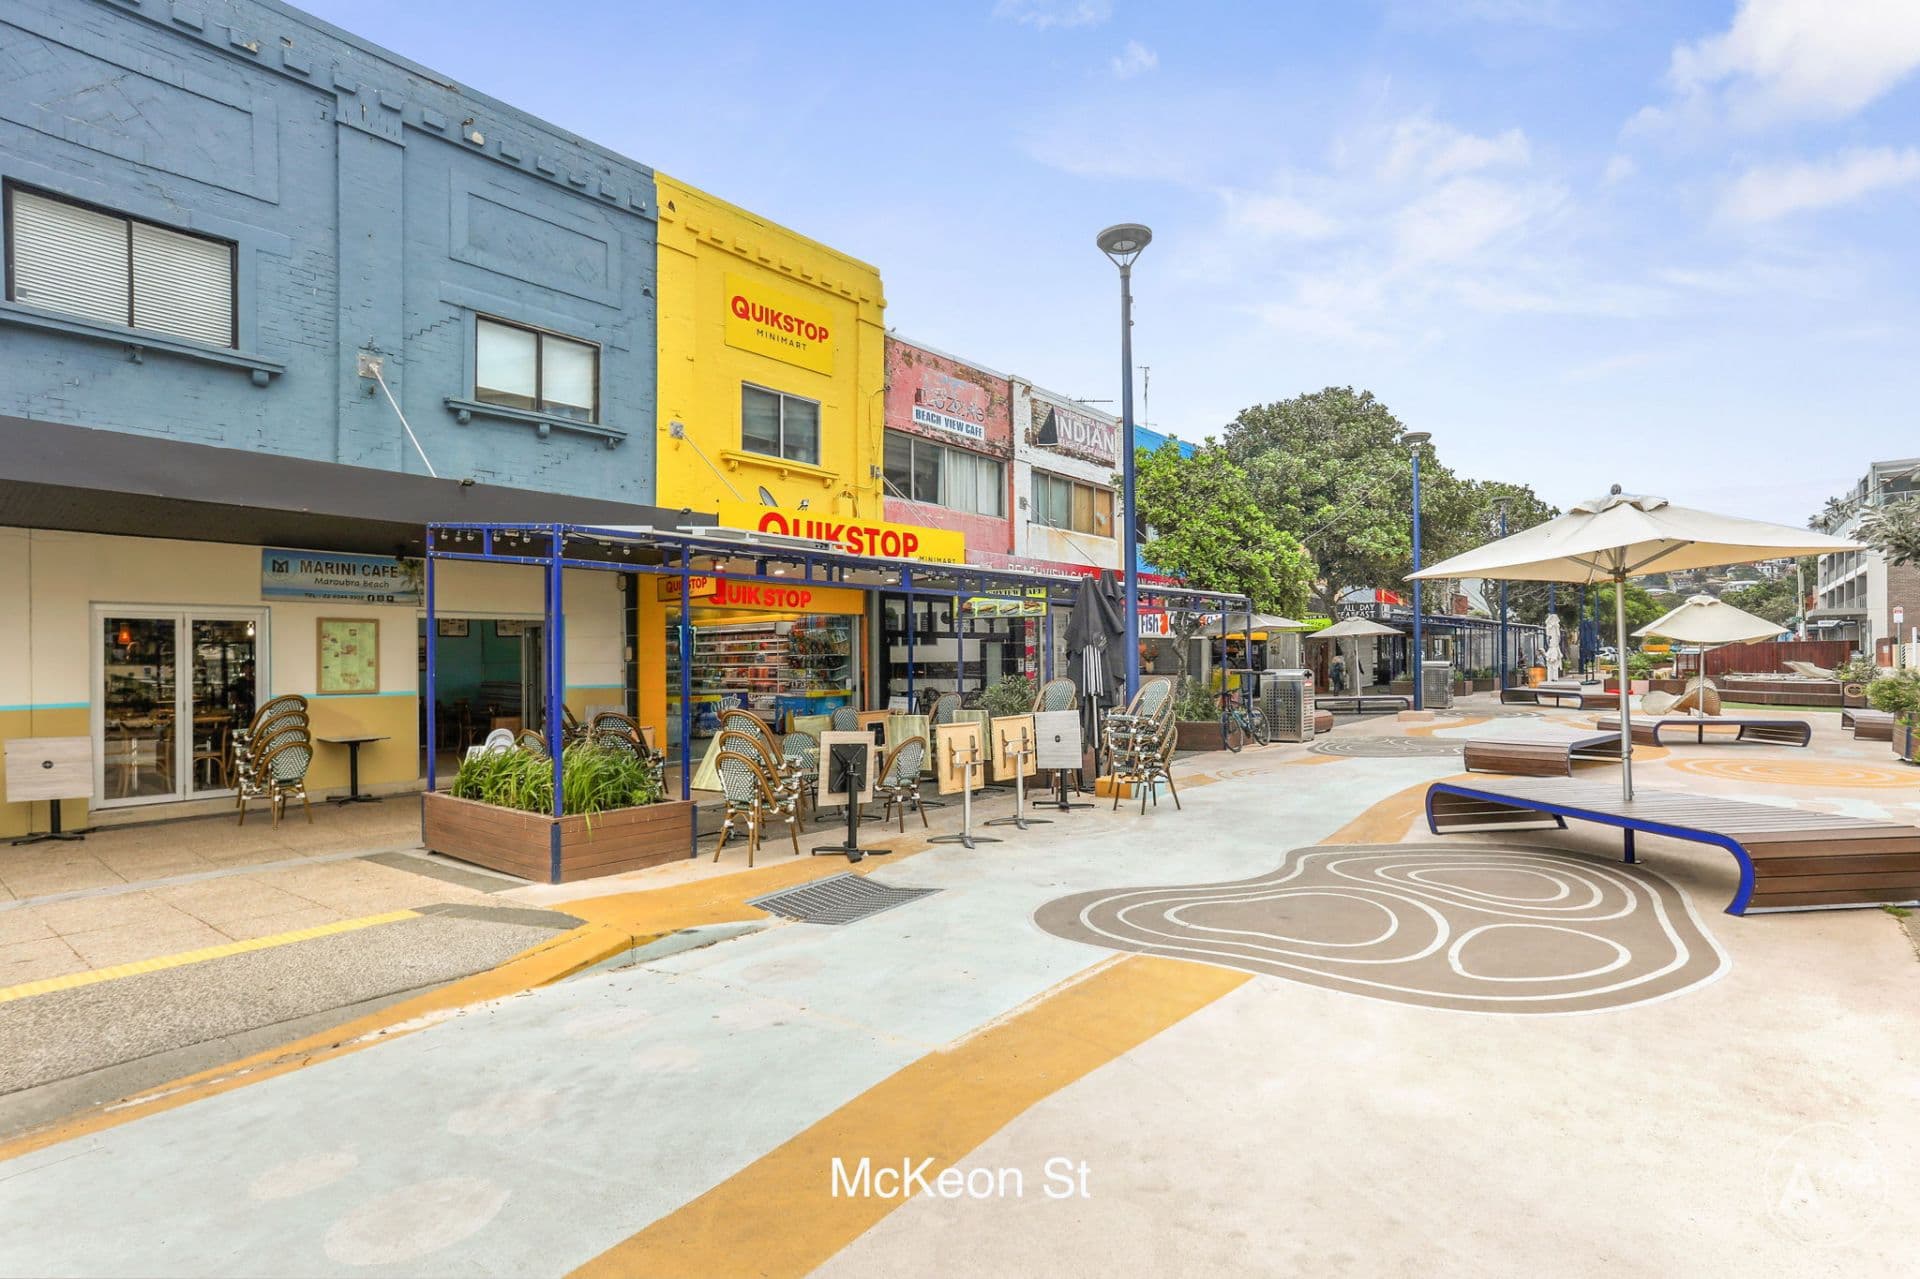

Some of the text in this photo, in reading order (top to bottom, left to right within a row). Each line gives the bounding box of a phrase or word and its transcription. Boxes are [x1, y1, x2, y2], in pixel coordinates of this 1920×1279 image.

[731, 295, 829, 343] QUIKSTOP
[756, 329, 807, 351] MINIMART
[915, 408, 983, 438] BEACH VIEW CAFE
[1055, 414, 1115, 454] INDIAN
[300, 559, 399, 578] MARINI CAFE
[314, 577, 360, 588] Maroubra
[666, 577, 707, 593] QUITOP
[764, 588, 812, 608] STOP
[1344, 603, 1375, 612] ALL DAY
